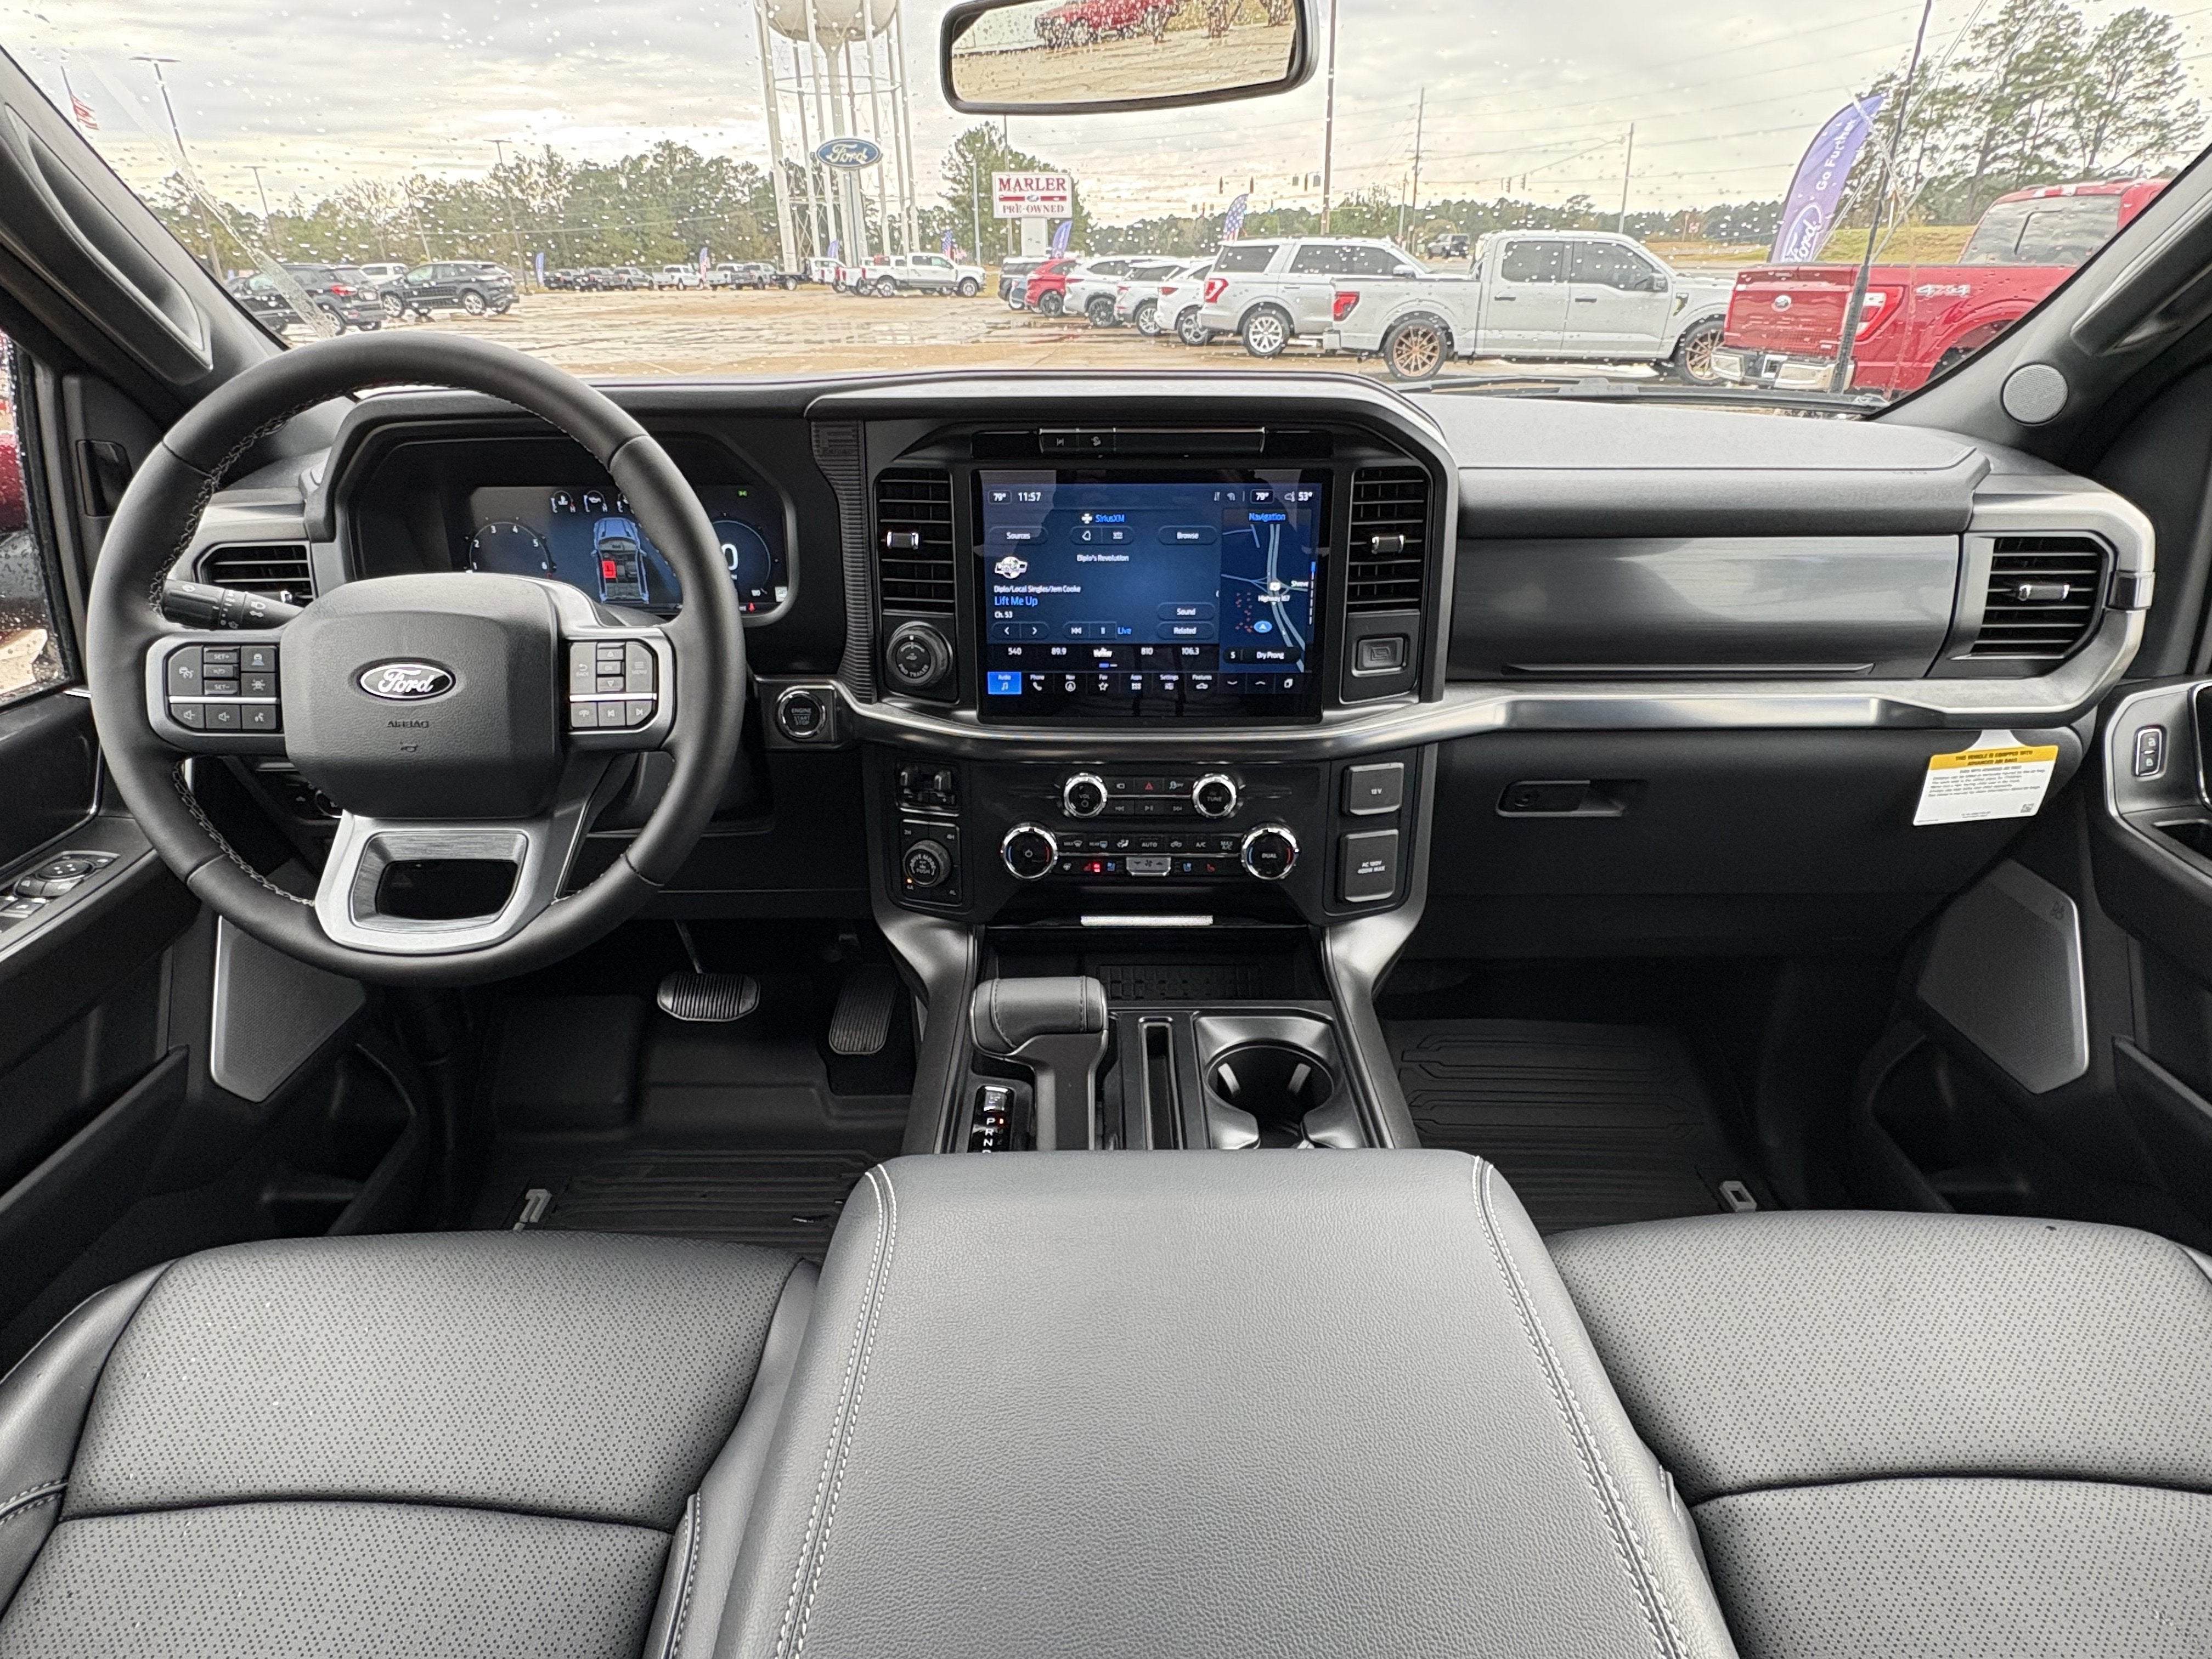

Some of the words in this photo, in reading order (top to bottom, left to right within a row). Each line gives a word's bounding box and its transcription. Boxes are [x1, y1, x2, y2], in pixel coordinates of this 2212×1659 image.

[826, 144, 868, 163] Ford
[998, 178, 1066, 191] MARLER
[1816, 171, 1831, 191] Go
[1003, 204, 1064, 213] PRE-OWNED
[1785, 219, 1820, 263] Ford
[1018, 492, 1041, 501] 11:57
[1298, 492, 1313, 501] 53°
[1095, 514, 1125, 522] SiriusXM
[1249, 513, 1286, 522] Navigation
[490, 525, 496, 533] 3
[512, 525, 518, 533] 4
[1006, 532, 1031, 540] Sources
[473, 539, 480, 548] 2
[533, 539, 539, 548] 5
[473, 562, 477, 570] 1
[541, 562, 548, 570] 6
[994, 585, 1027, 594] Diplo/Local
[994, 596, 1009, 606] Lift
[1011, 596, 1024, 606] Me
[1025, 596, 1039, 607] Up
[378, 669, 434, 692] Ford
[983, 1138, 993, 1147] N
